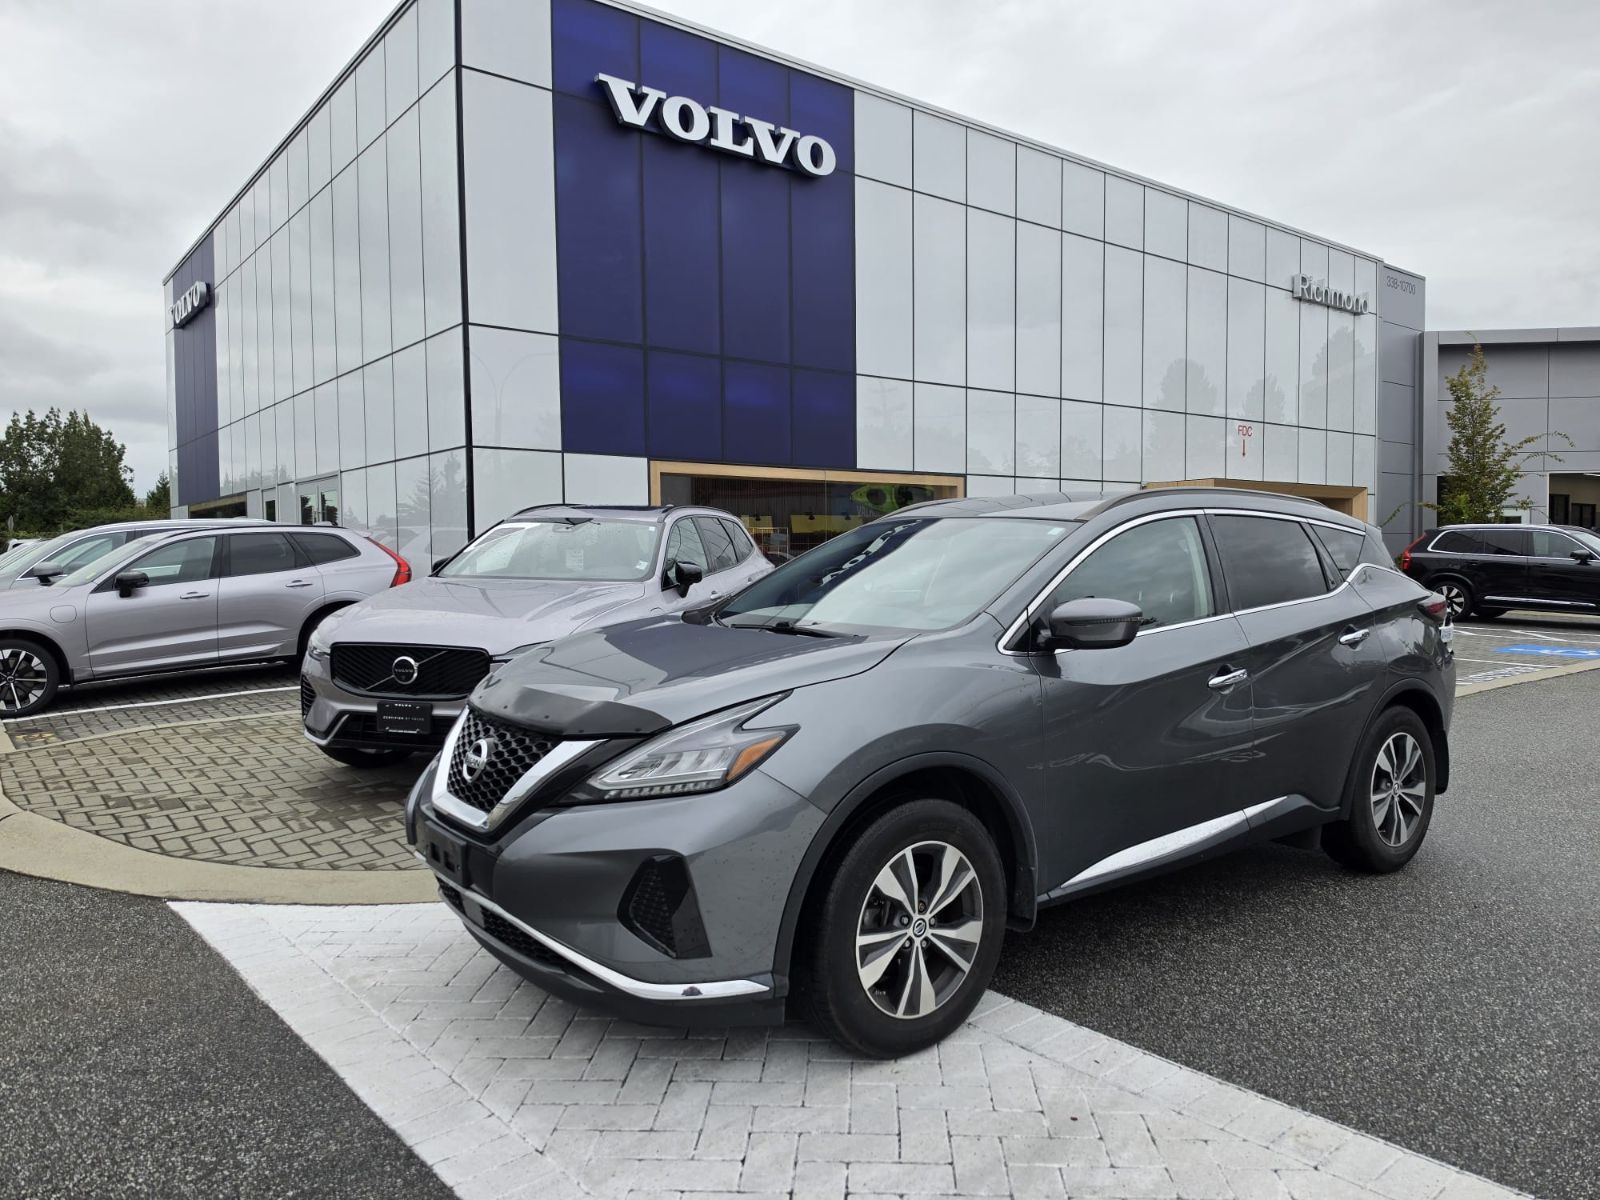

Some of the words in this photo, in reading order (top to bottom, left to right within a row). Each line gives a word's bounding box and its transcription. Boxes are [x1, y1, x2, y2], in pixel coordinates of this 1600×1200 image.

[594, 72, 836, 176] VOLVO
[168, 280, 203, 325] VOLVO
[1292, 272, 1369, 314] Richmond
[1237, 424, 1253, 437] FDC
